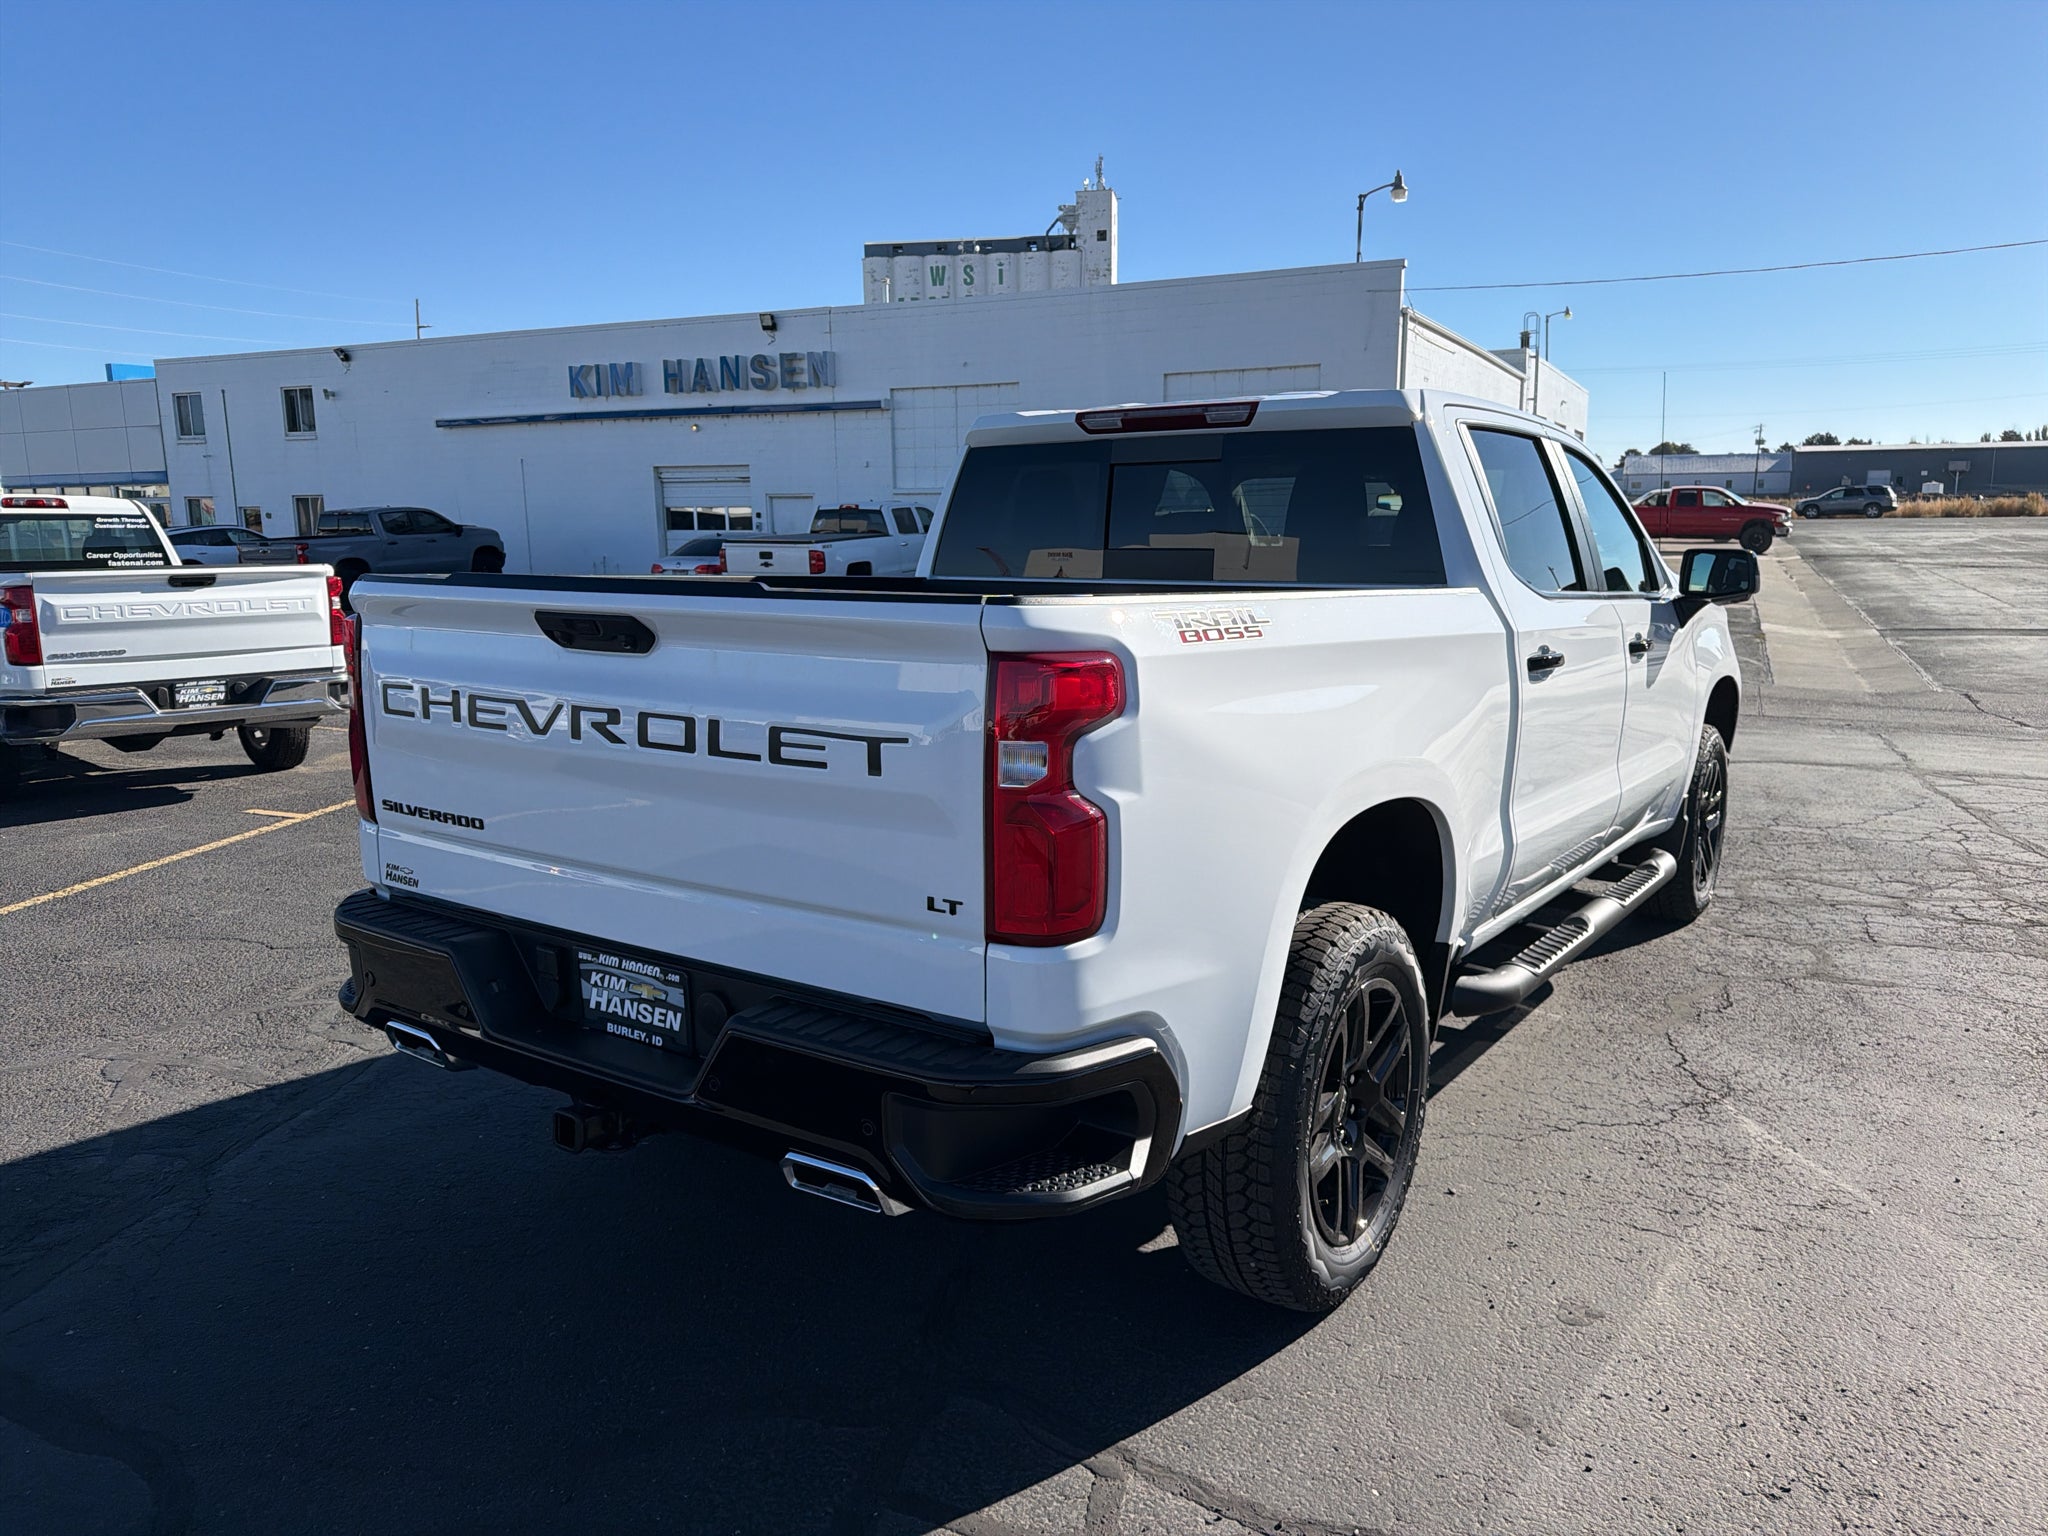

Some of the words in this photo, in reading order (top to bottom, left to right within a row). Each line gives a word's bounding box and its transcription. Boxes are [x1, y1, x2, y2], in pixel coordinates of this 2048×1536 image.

[568, 361, 643, 399] KIM
[663, 351, 836, 394] HANSEN
[113, 551, 163, 560] Opportunities
[60, 598, 313, 621] CHEVROLET
[1152, 607, 1272, 629] TRAIL
[1178, 625, 1263, 644] BOSS
[178, 692, 225, 703] HANSEN
[382, 681, 909, 777] CHEVROLET
[382, 799, 485, 831] SILVERADO
[386, 862, 400, 872] KIM
[385, 870, 419, 888] HANSEN
[927, 896, 964, 916] LT
[598, 953, 619, 967] KIM
[621, 959, 661, 978] HANSEN
[590, 971, 627, 993] KIM
[589, 987, 682, 1032] HANSEN
[606, 1022, 649, 1043] BURLEY,
[652, 1034, 663, 1047] ID
